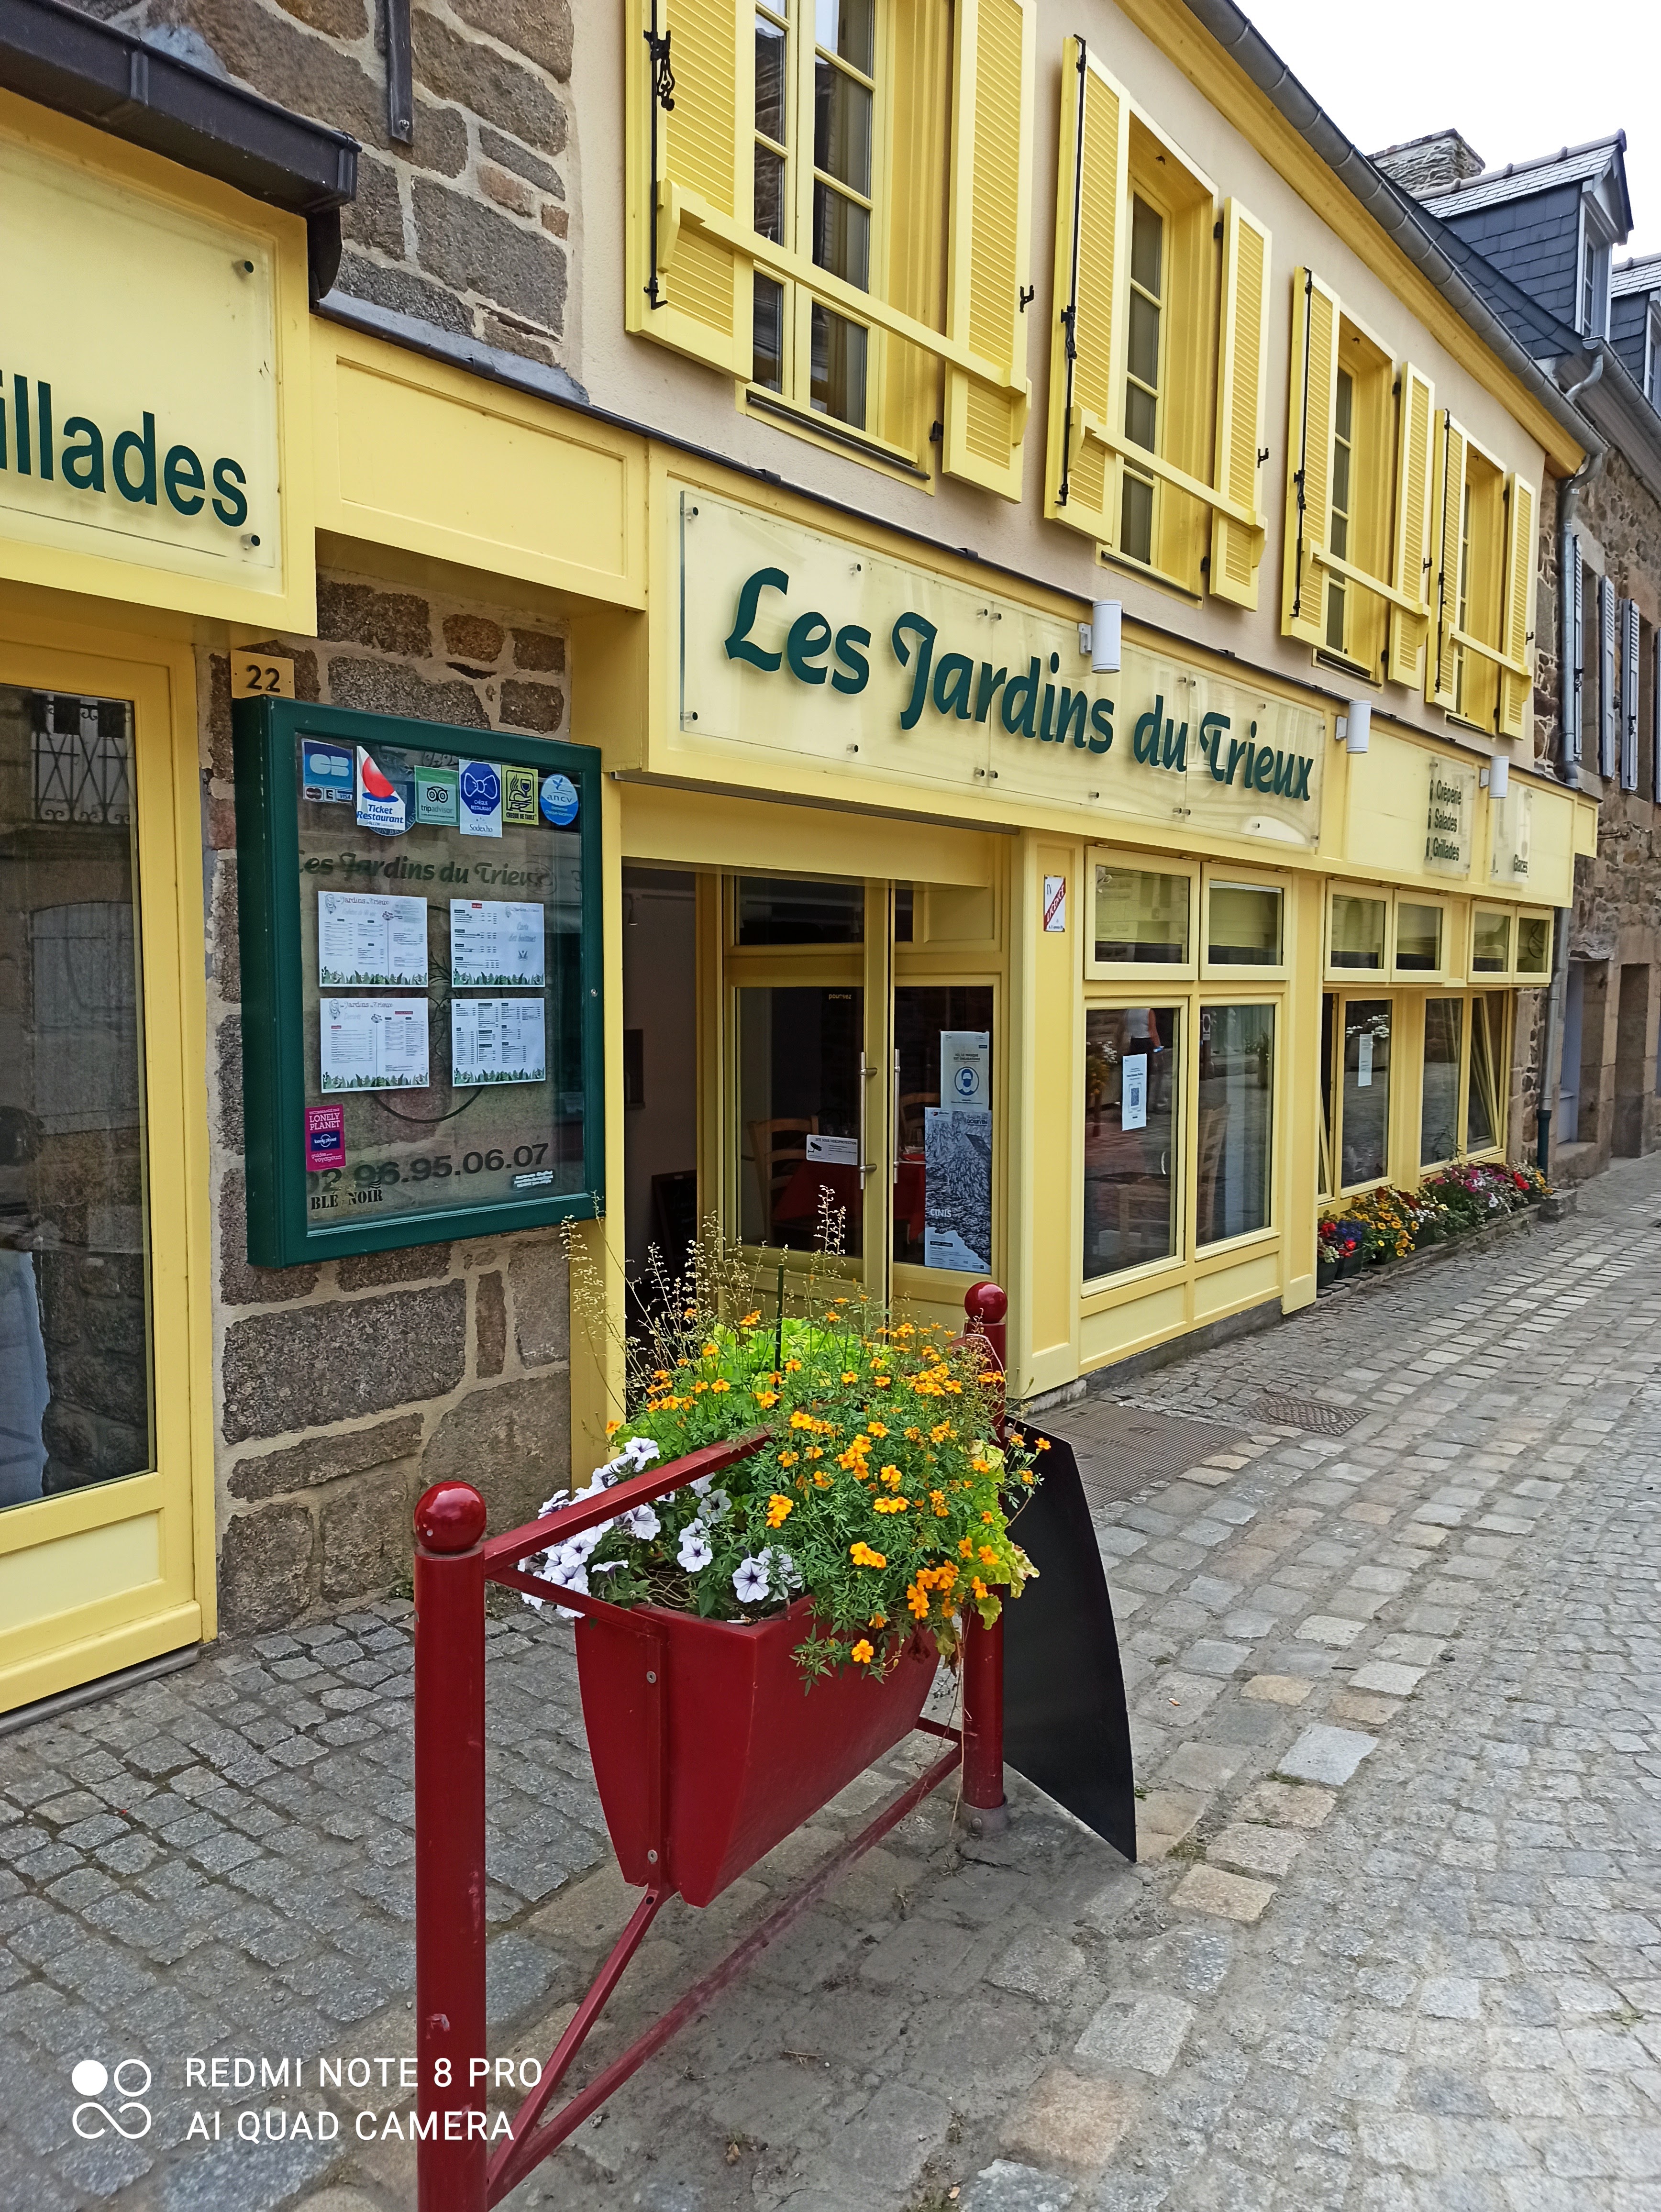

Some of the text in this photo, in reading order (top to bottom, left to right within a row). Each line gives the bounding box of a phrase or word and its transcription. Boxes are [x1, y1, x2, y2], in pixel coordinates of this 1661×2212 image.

[246, 664, 281, 693] 22
[725, 567, 1314, 801] Les Jardins du Trieux
[547, 794, 572, 803] ancv
[1437, 779, 1462, 806] Crêperie
[368, 804, 393, 815] Ticket
[421, 804, 453, 813] tripadvisor
[357, 811, 404, 824] Restaurant
[1435, 808, 1458, 833] Salades
[469, 824, 493, 833] Sodexho
[1433, 837, 1459, 862] Grillades
[338, 852, 434, 881] Jardins
[440, 861, 469, 884] du
[1047, 884, 1064, 922] LICENCE
[309, 1112, 340, 1123] LONELY
[310, 1120, 341, 1131] PLANET
[311, 1189, 383, 1210] BLÉ NOIR
[930, 1208, 952, 1218] CINIS
